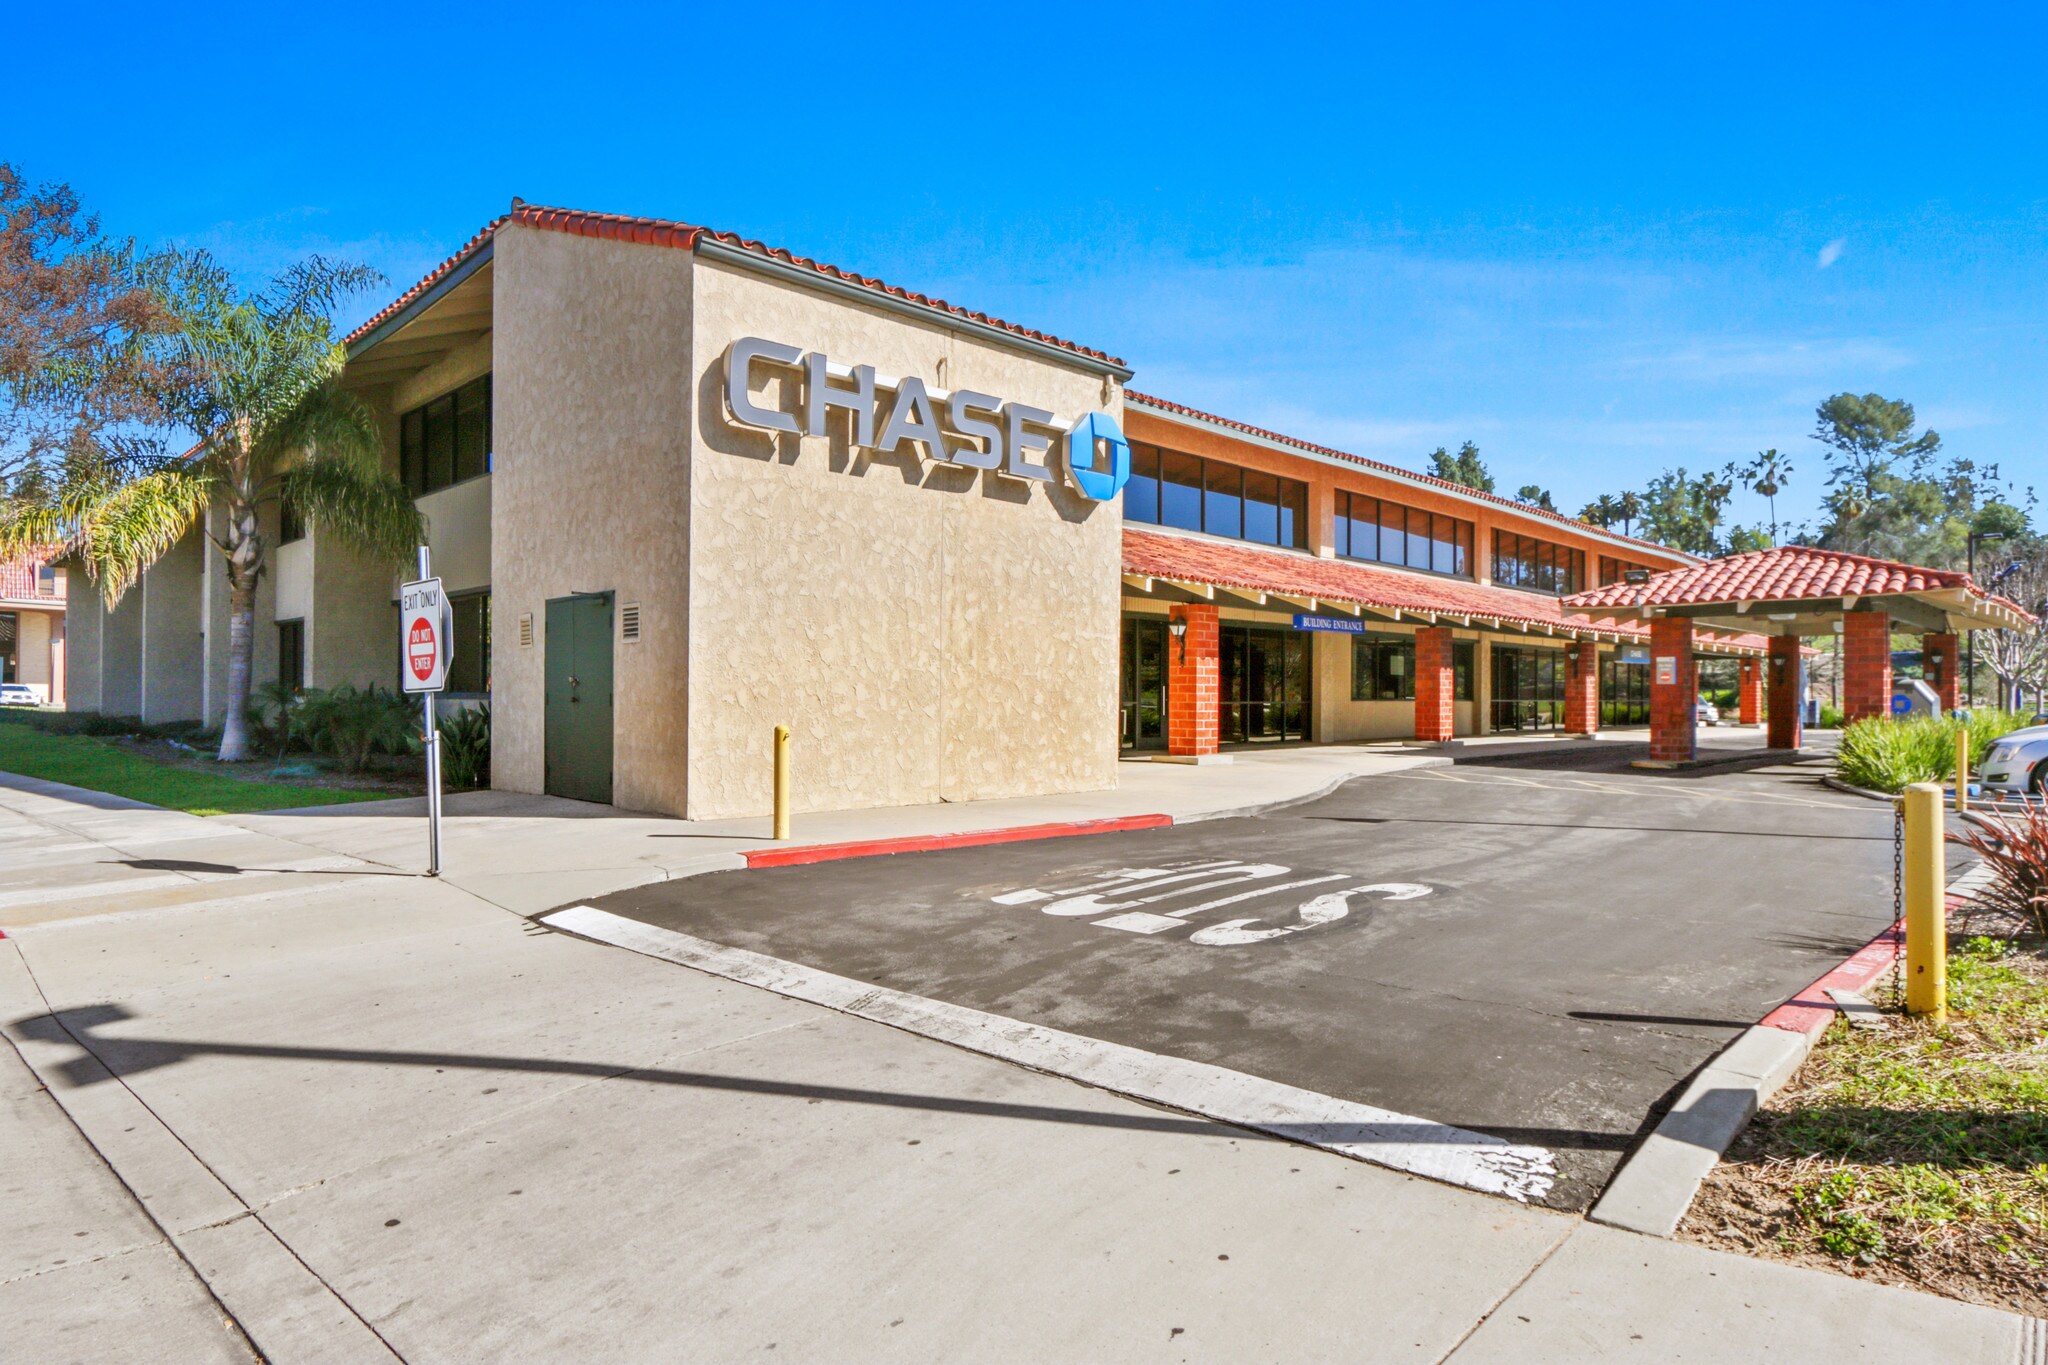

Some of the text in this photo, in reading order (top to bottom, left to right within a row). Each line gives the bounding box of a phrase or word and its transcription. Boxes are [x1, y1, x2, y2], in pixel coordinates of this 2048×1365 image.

[724, 336, 1055, 483] CHASE
[404, 590, 437, 610] EXIT ONLY
[1303, 617, 1362, 631] BUILDING ENTRANCE
[412, 628, 431, 643] DO NOT
[415, 657, 431, 670] ENTER
